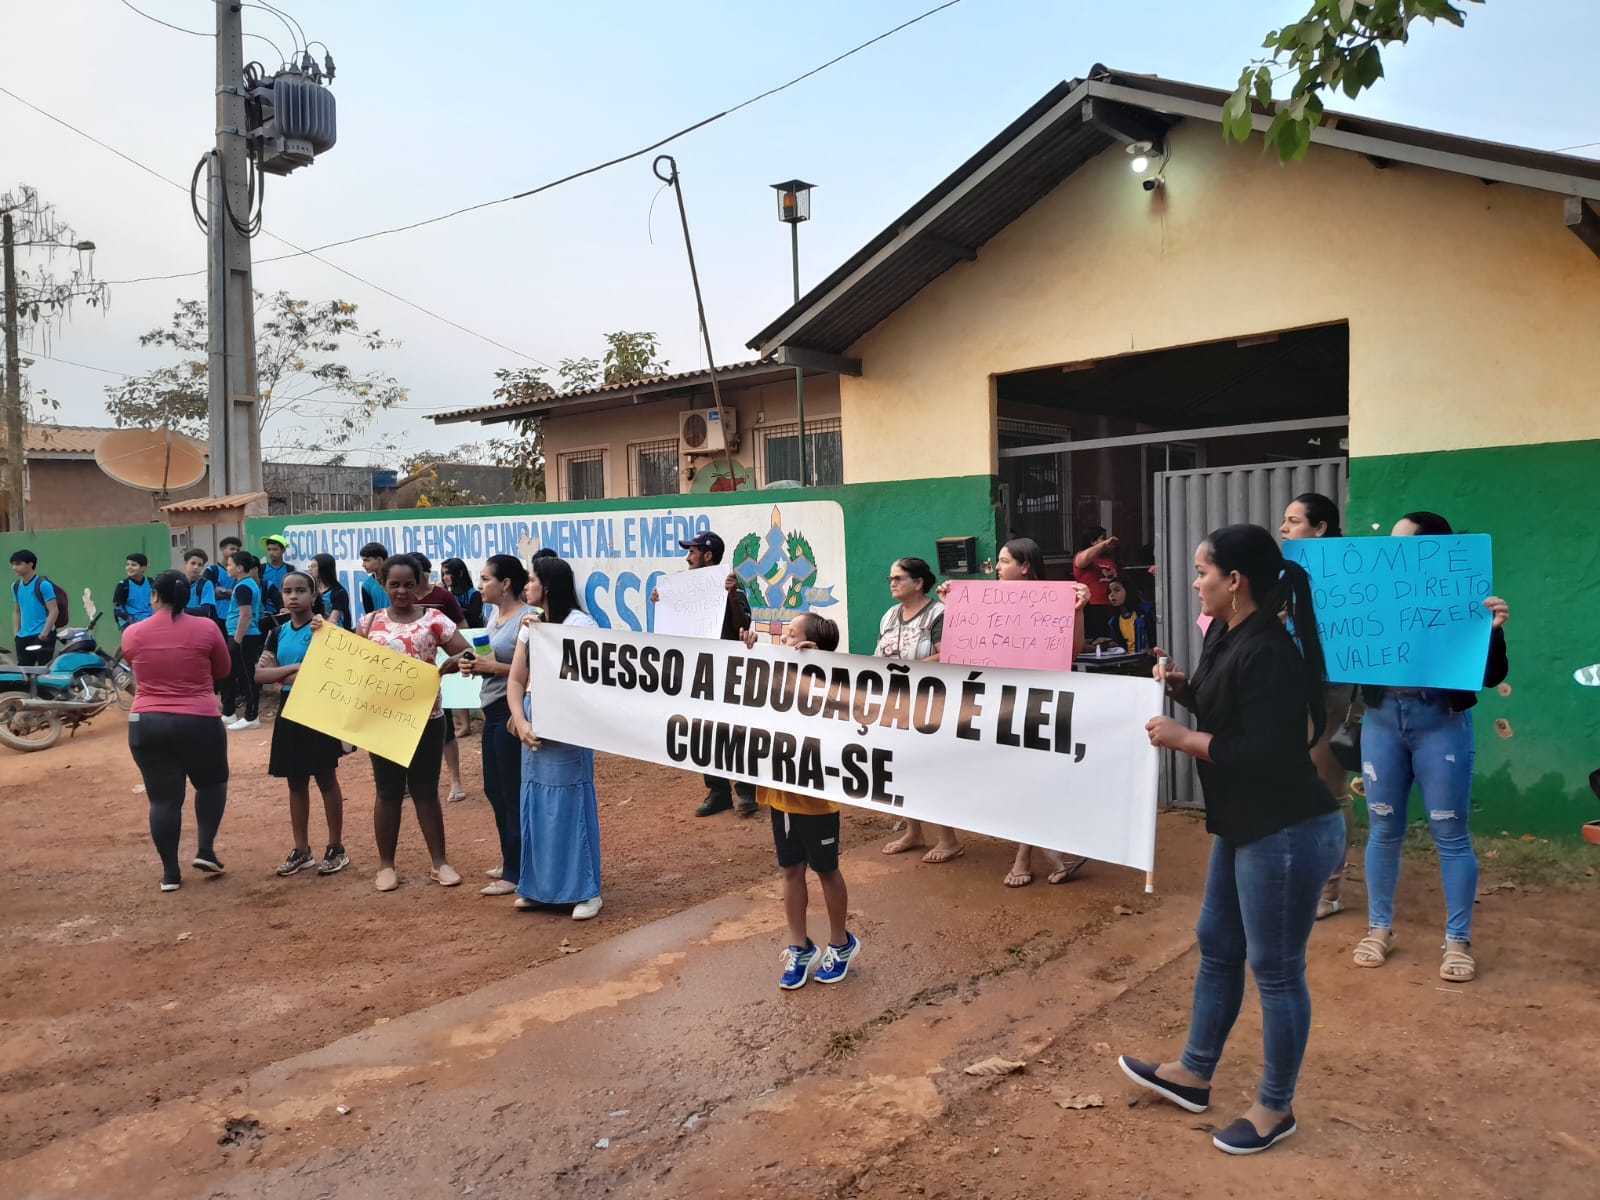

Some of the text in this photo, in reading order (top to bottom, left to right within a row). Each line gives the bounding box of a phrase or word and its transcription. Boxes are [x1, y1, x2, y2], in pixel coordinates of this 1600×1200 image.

[283, 529, 329, 561] ESCOLA
[403, 525, 422, 558] DE
[424, 522, 482, 559] ENSINO
[624, 517, 637, 558] E
[958, 585, 1058, 608] A EDUCAÇÃO
[1313, 573, 1490, 610] OSSO DIREITO
[987, 611, 1021, 629] TEM
[1317, 600, 1484, 641] AMOS FAZER
[953, 633, 987, 650] SUA
[991, 633, 1037, 650] FALTA
[1336, 641, 1410, 671] VALER
[324, 657, 415, 701] E DIREITO
[559, 638, 1086, 763] ACESSO A EDUCAÇÃO É LEI,
[666, 714, 904, 807] CUMPRA-SE.
